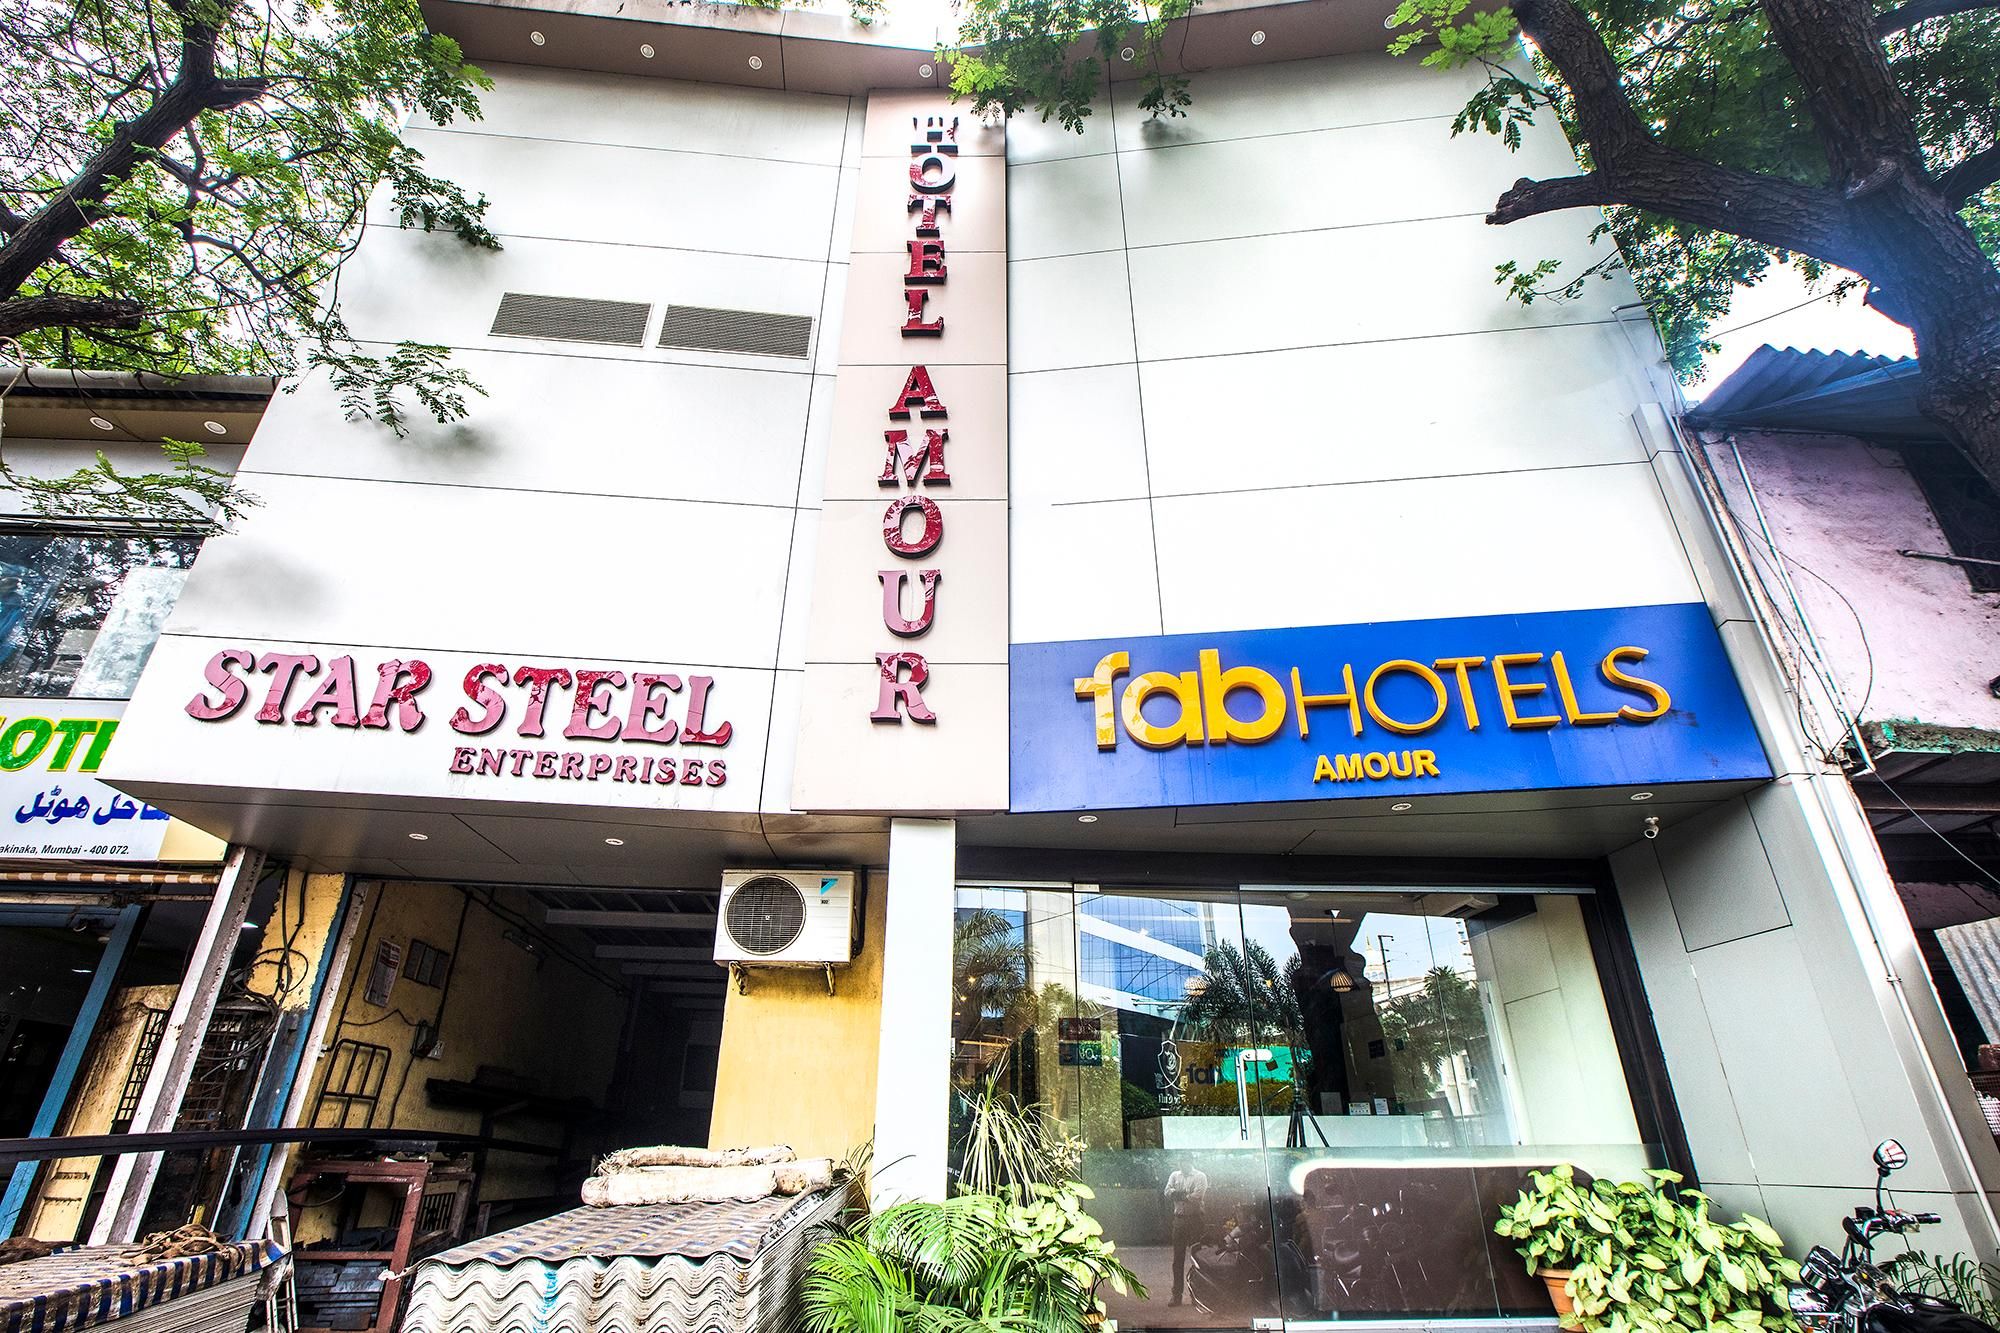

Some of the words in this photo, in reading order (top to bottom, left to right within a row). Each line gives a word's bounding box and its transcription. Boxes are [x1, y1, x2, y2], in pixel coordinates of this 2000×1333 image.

[901, 116, 959, 338] HOTEL
[870, 365, 950, 725] AMOUR
[184, 649, 435, 733] STAR
[449, 663, 734, 748] STEEL
[449, 746, 728, 787] ENTERPRISES
[1312, 749, 1441, 784] AMOUR
[41, 844, 81, 855] Mumbai
[89, 845, 108, 854] 400
[109, 845, 129, 855] 072.
